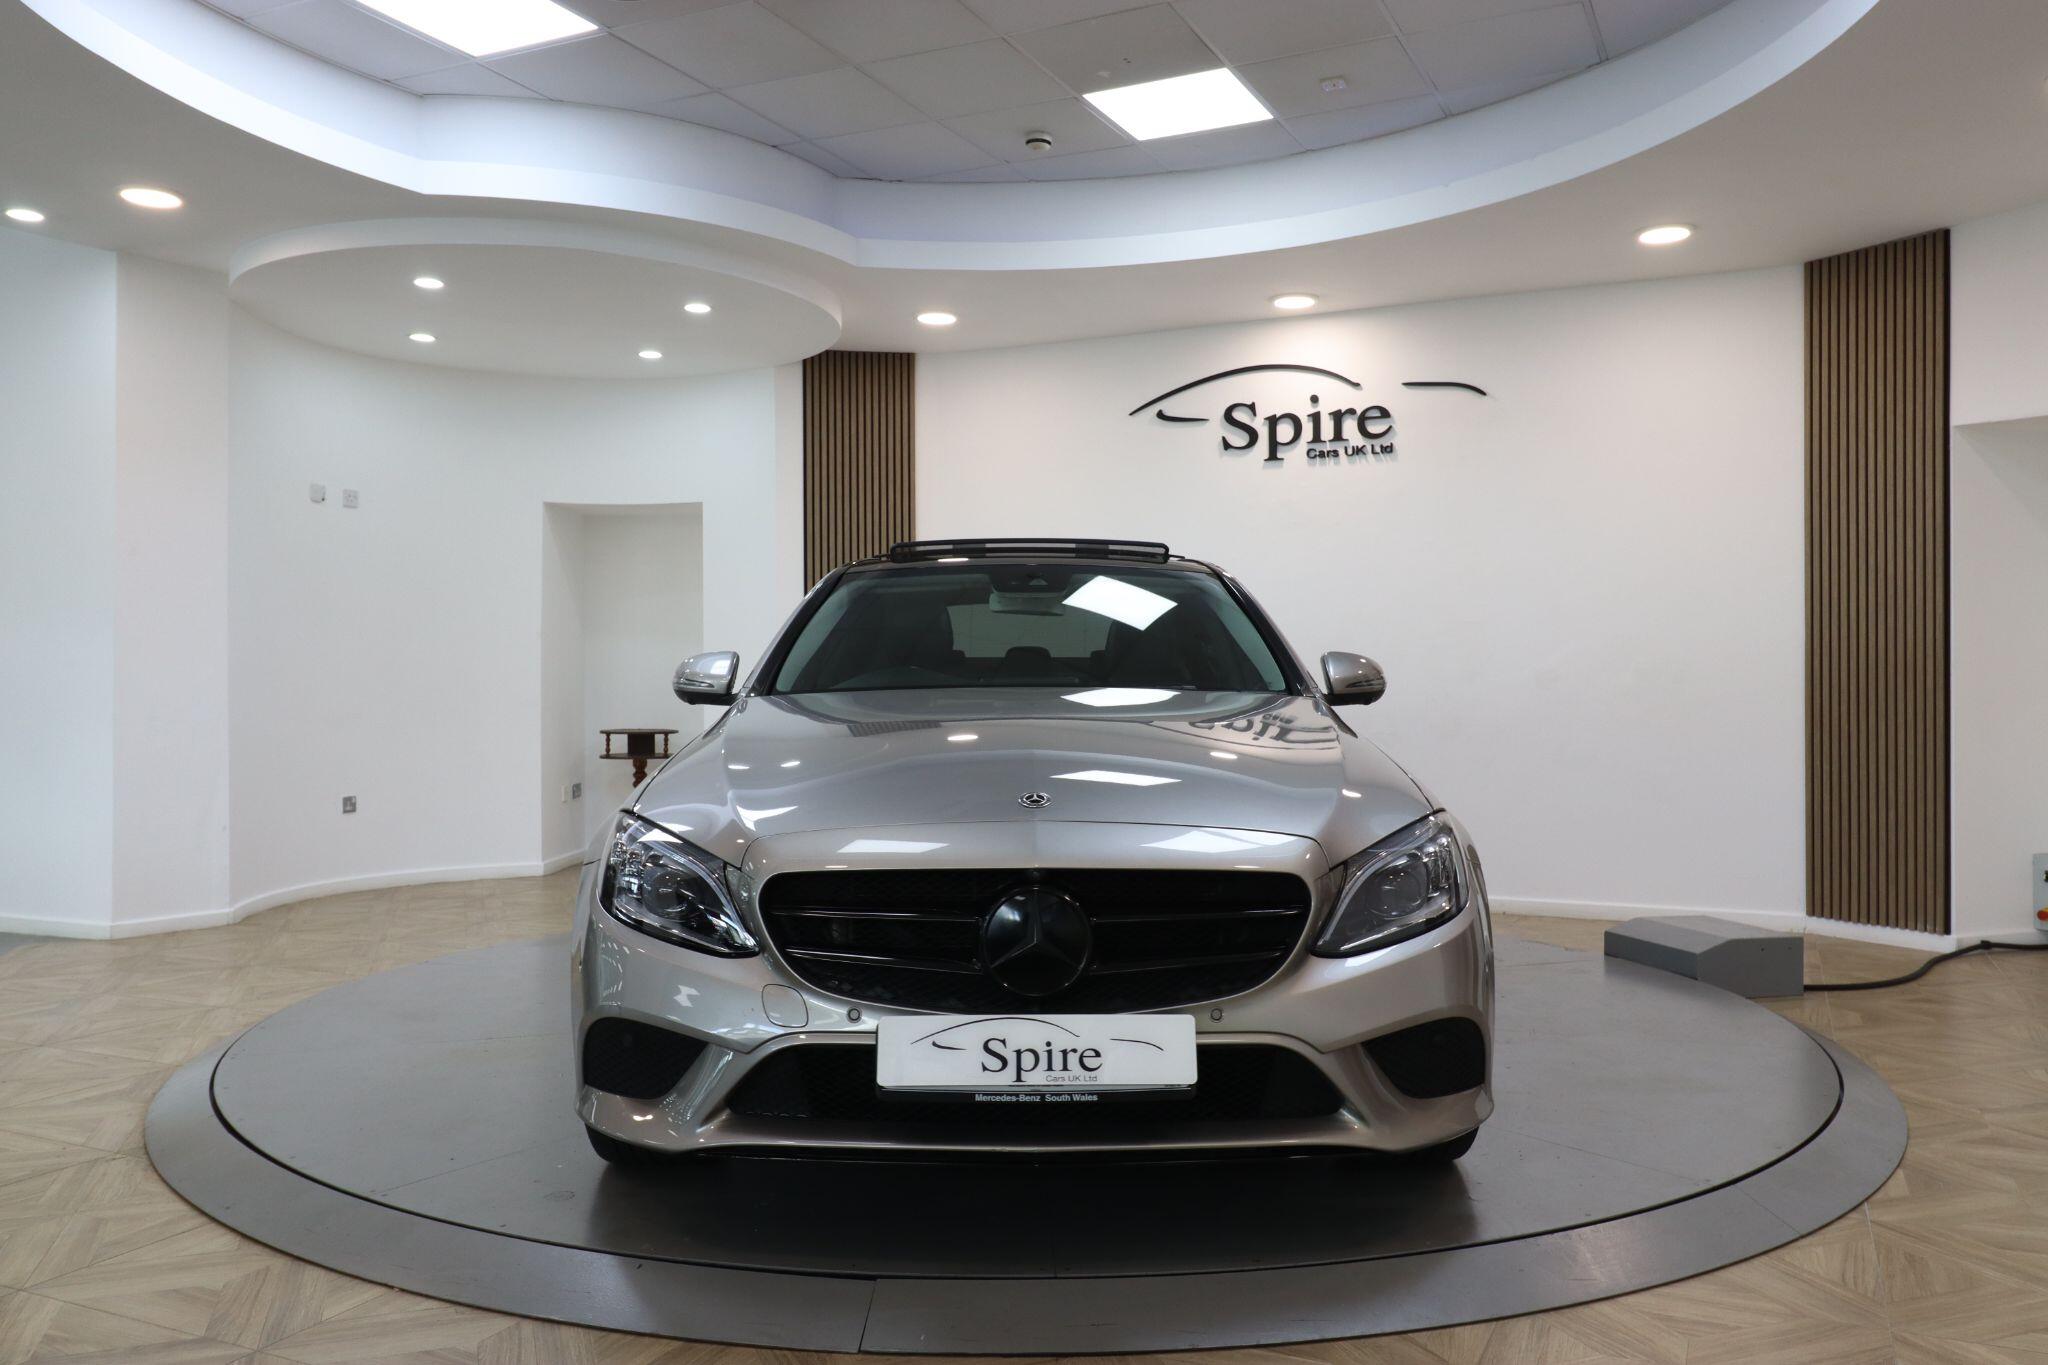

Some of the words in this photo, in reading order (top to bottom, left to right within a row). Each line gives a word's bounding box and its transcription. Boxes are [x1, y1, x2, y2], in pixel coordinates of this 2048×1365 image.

[1222, 395, 1393, 462] Spire
[1306, 448, 1339, 460] Cars
[1344, 445, 1367, 457] UK
[1371, 442, 1394, 455] Ltd
[981, 1037, 1103, 1083] Spire
[1045, 1074, 1066, 1083] Cars
[1068, 1074, 1081, 1083] UK
[1083, 1074, 1099, 1083] Ltd
[975, 1093, 1041, 1102] Mercedes-Benz
[1045, 1093, 1071, 1102] South
[1072, 1093, 1098, 1102] Wales
